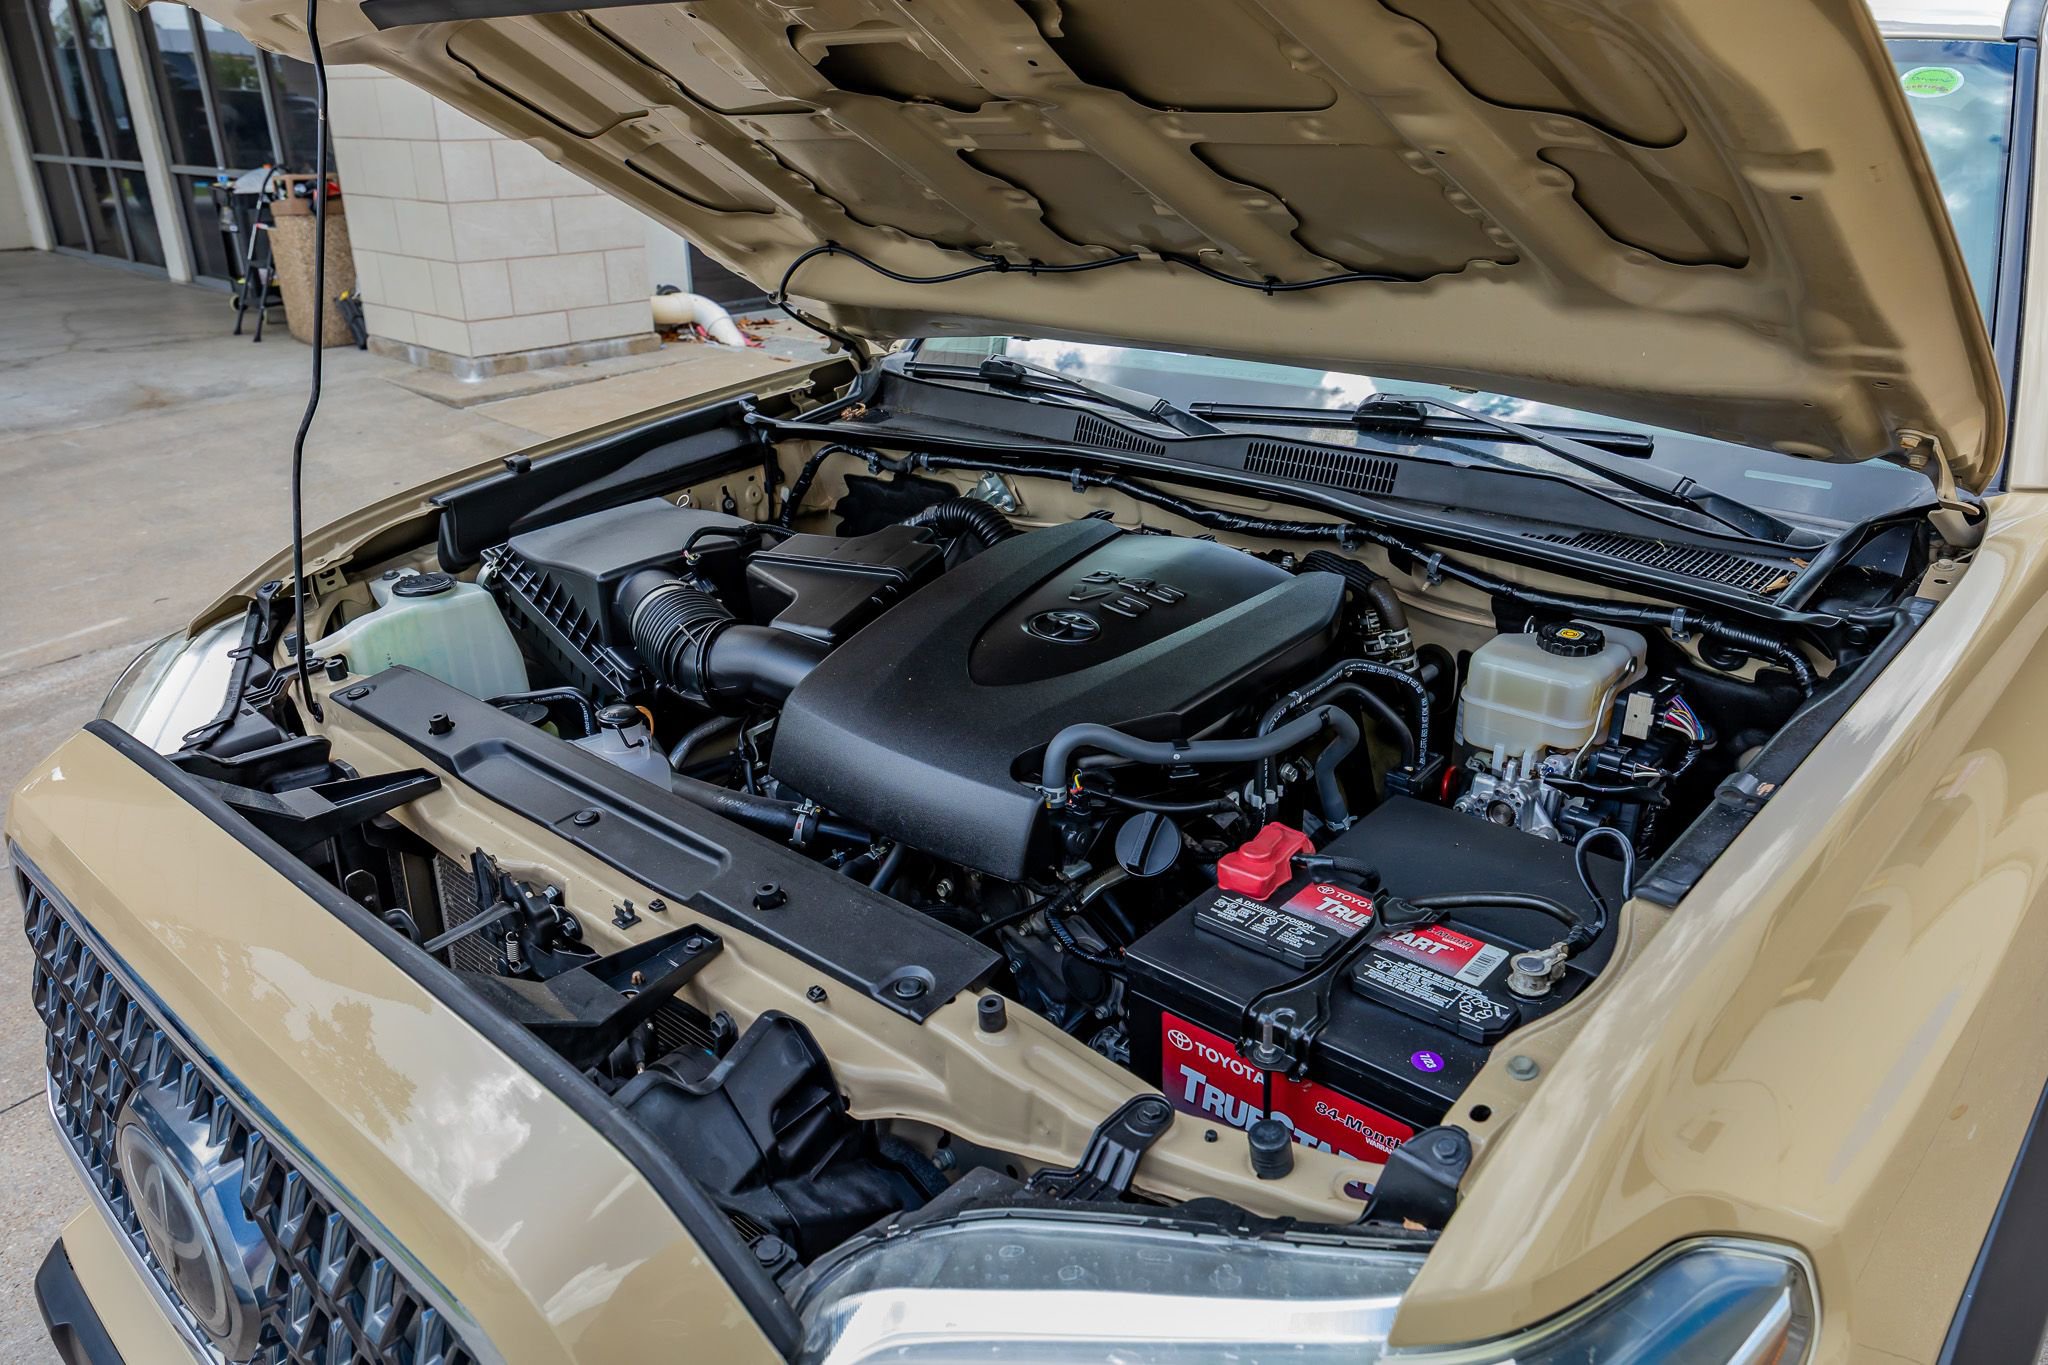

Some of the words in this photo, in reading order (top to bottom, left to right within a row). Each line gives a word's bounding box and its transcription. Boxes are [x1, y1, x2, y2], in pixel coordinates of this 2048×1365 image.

[1336, 891, 1374, 911] TOYOT
[1388, 931, 1451, 956] ART
[1195, 1041, 1265, 1085] TOYOTA
[1365, 1137, 1395, 1155] WARRAN
